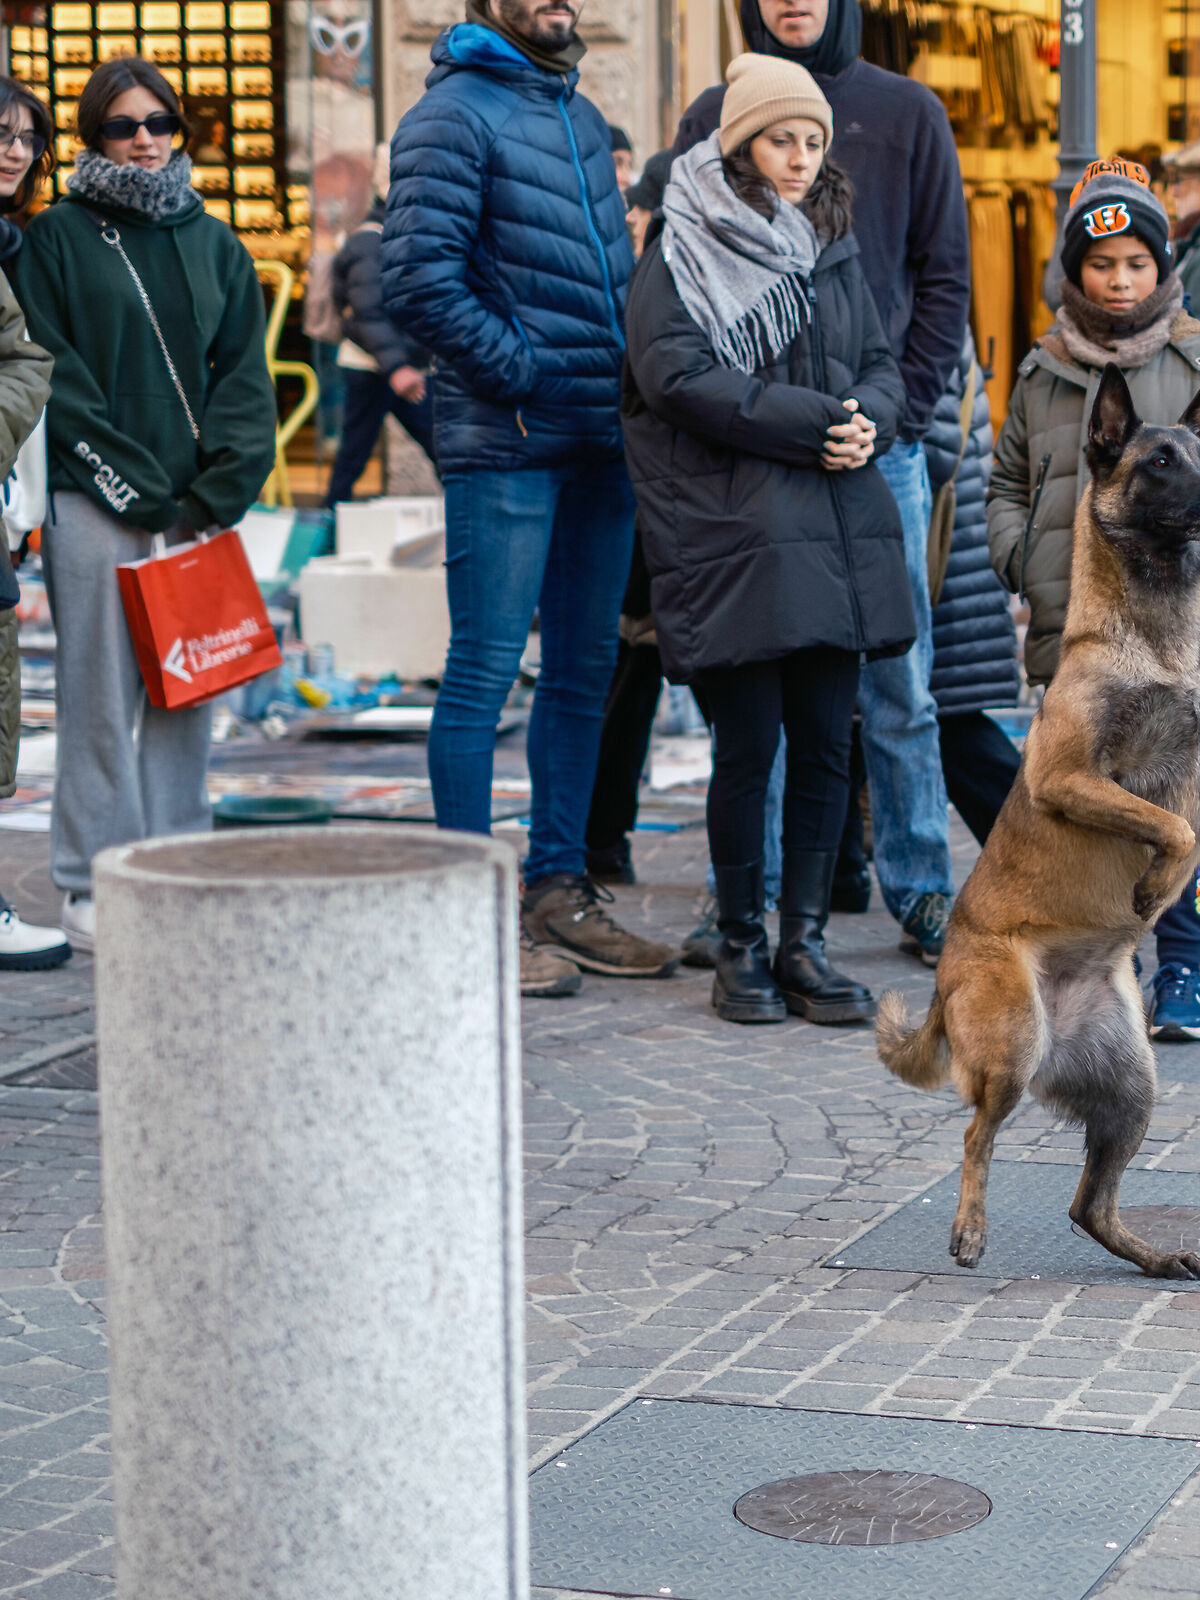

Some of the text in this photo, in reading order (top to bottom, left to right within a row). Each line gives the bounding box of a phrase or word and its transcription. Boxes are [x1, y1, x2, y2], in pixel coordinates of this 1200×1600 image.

[1064, 0, 1084, 46] 3
[74, 441, 140, 503] SCOUT
[186, 616, 260, 656] Feltrinelli
